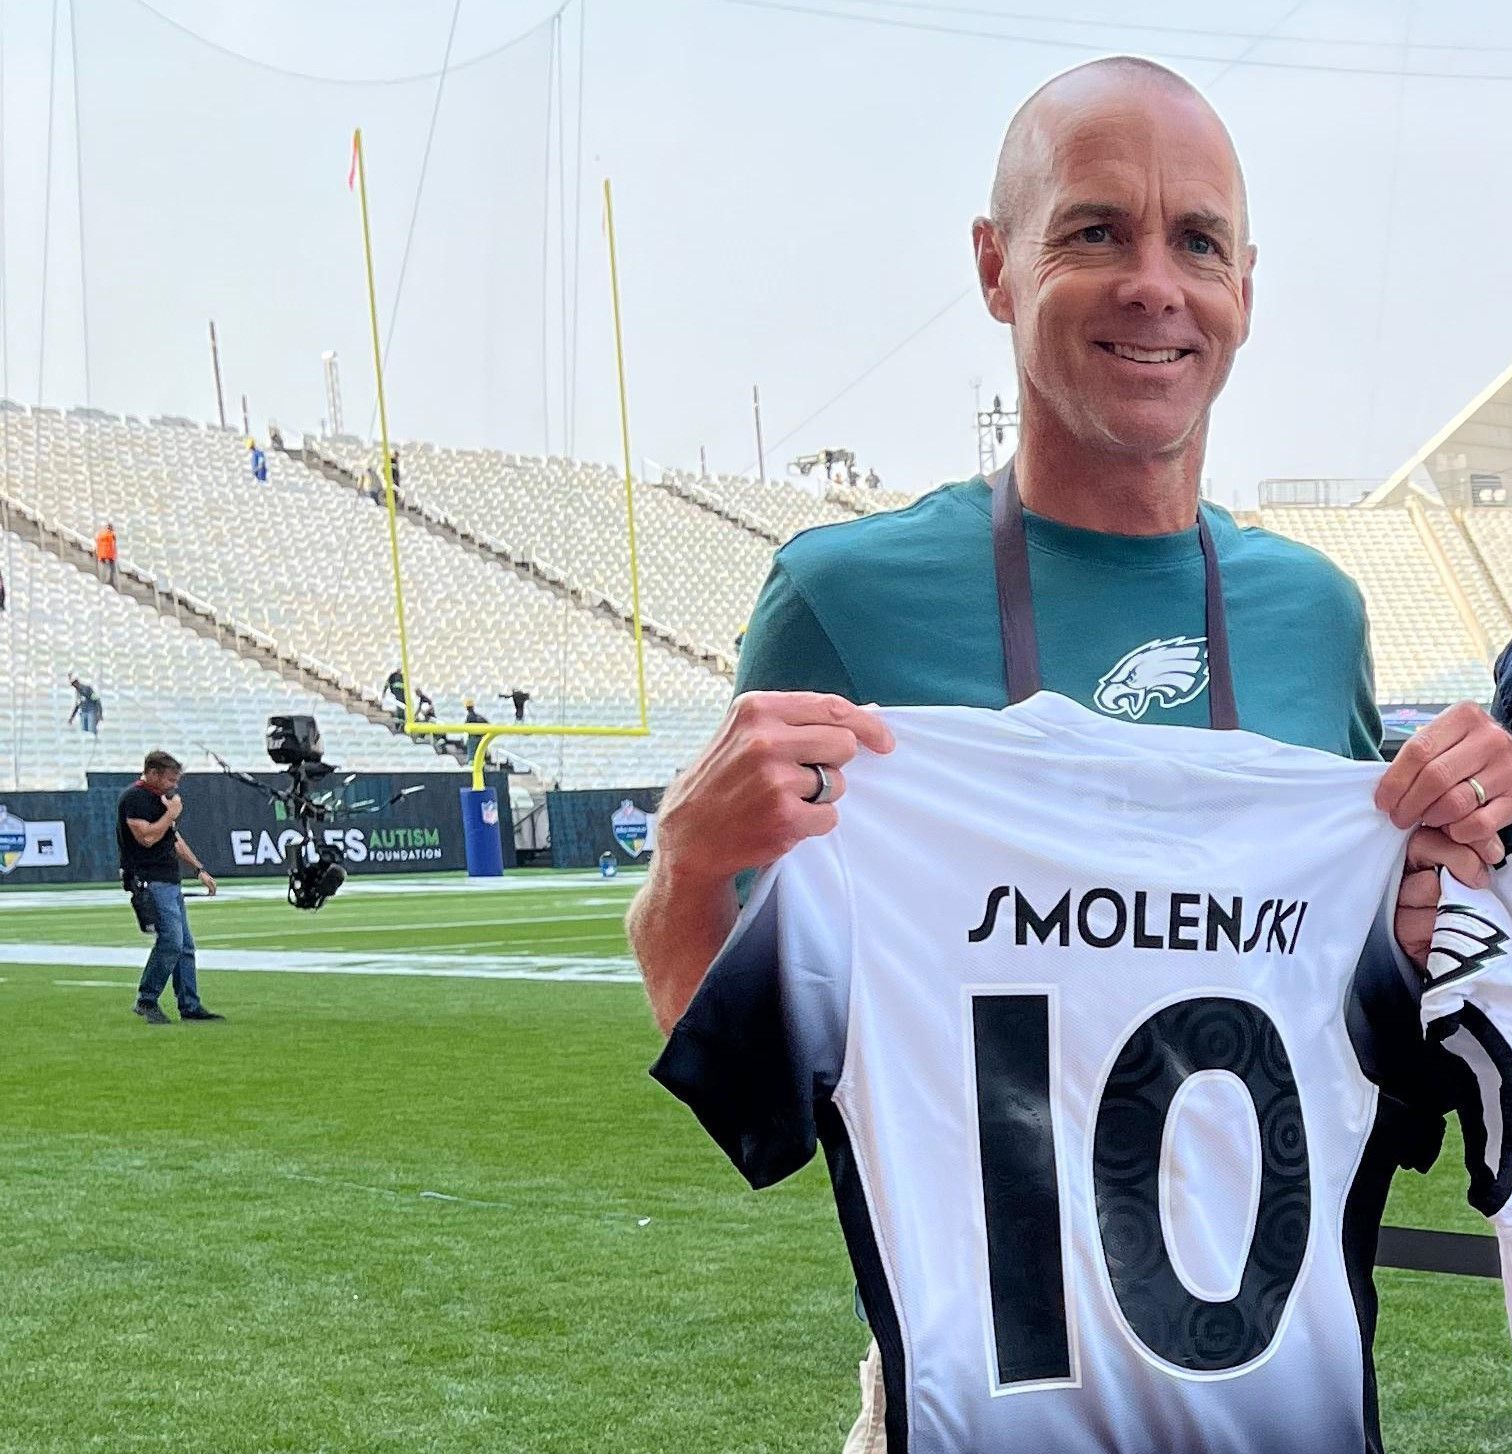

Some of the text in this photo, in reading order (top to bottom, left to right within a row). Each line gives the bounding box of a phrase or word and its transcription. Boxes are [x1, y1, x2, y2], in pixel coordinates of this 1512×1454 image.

[369, 828, 440, 848] AUTISM
[369, 848, 442, 861] FOUNDATION
[967, 885, 1309, 955] SMOLENSKI
[961, 983, 1316, 1398] 10
